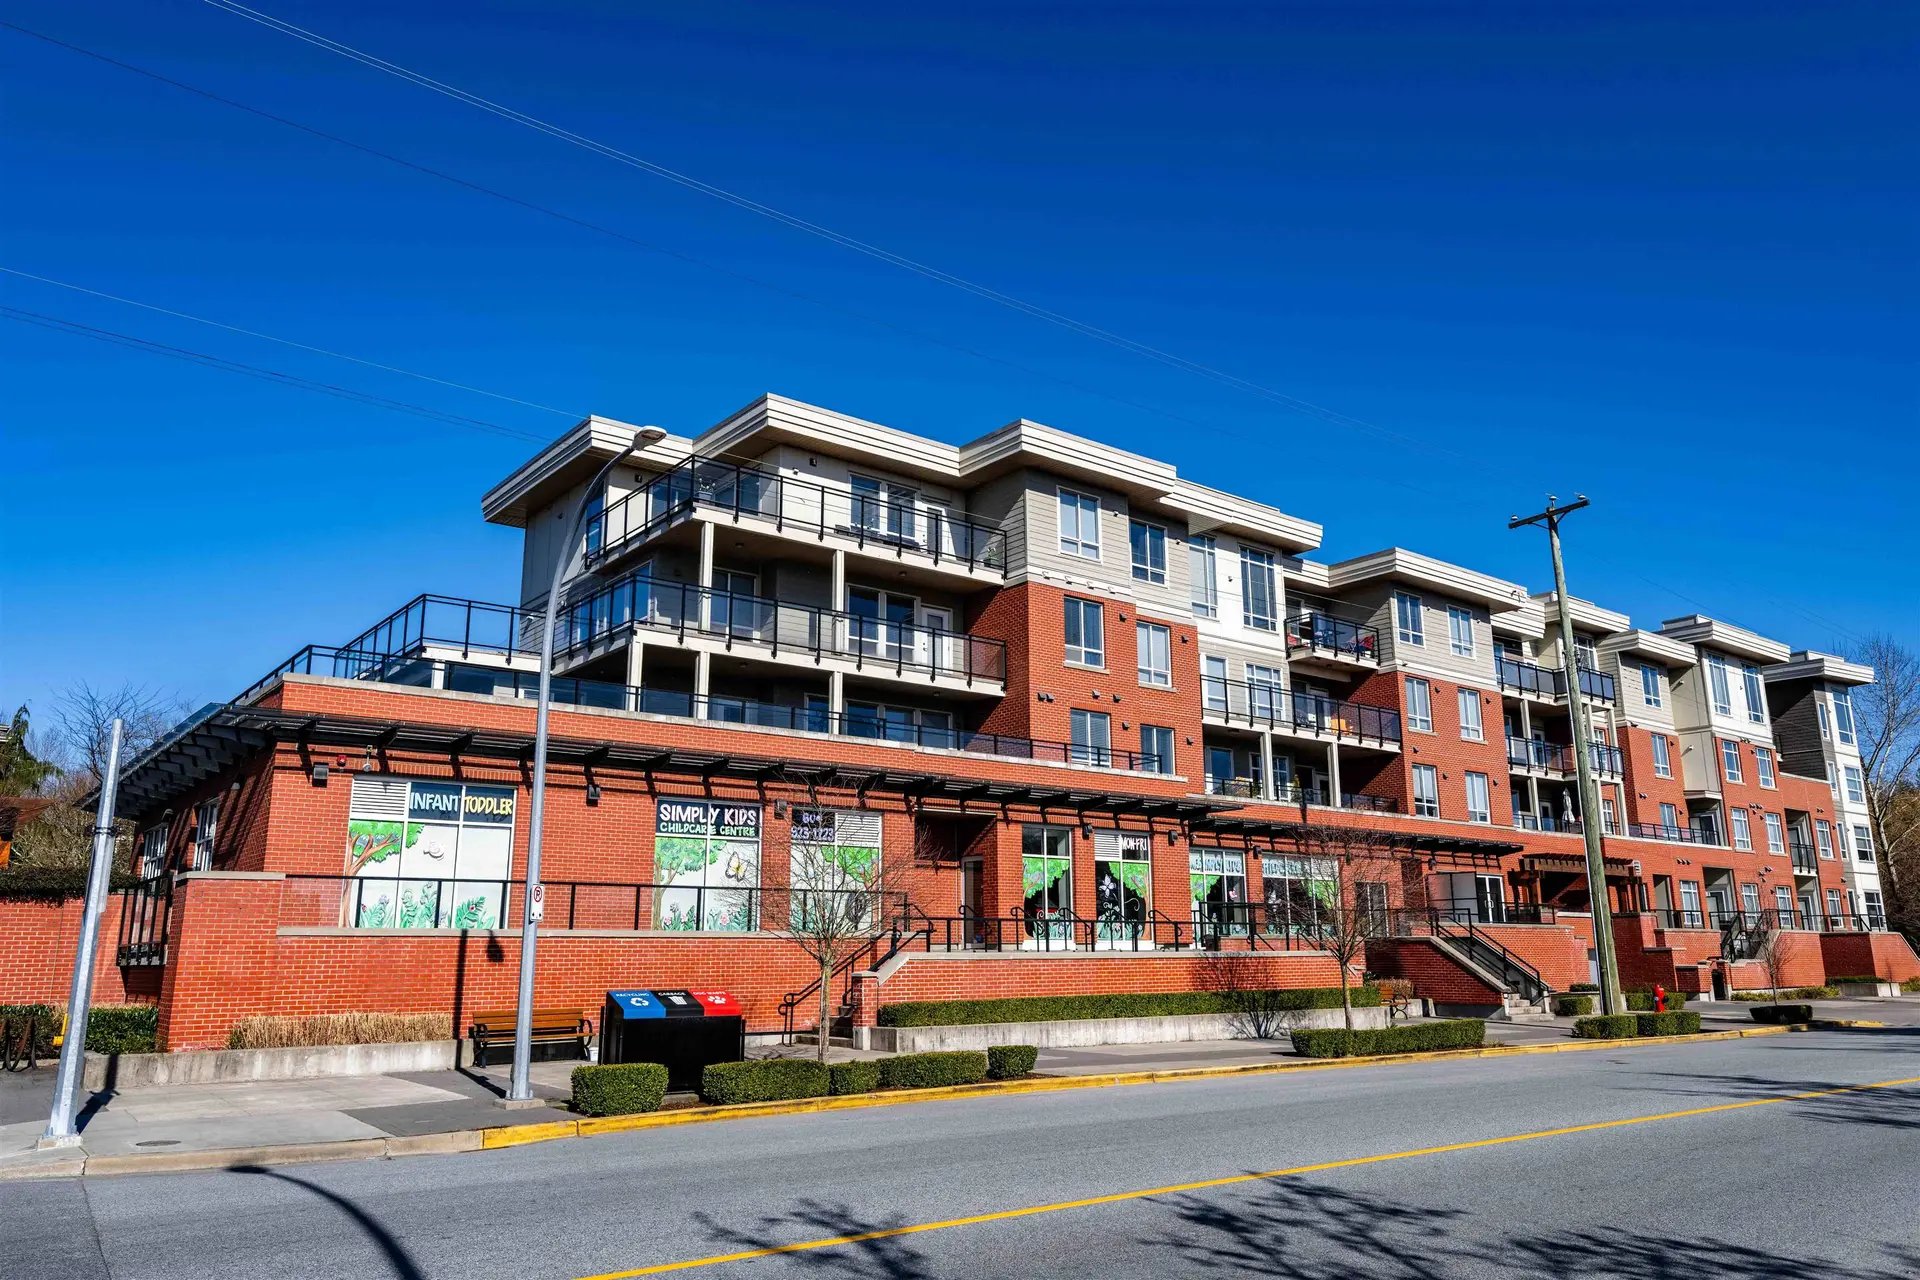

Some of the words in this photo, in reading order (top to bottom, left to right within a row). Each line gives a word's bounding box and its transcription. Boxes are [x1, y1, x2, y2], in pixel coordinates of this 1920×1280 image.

[409, 792, 461, 812] INFANT
[464, 796, 513, 815] TODDLER
[660, 804, 720, 824] SIMPLY
[724, 808, 757, 826] KIDS
[660, 822, 717, 835] CHILDCARE
[720, 826, 755, 837] CENTRE
